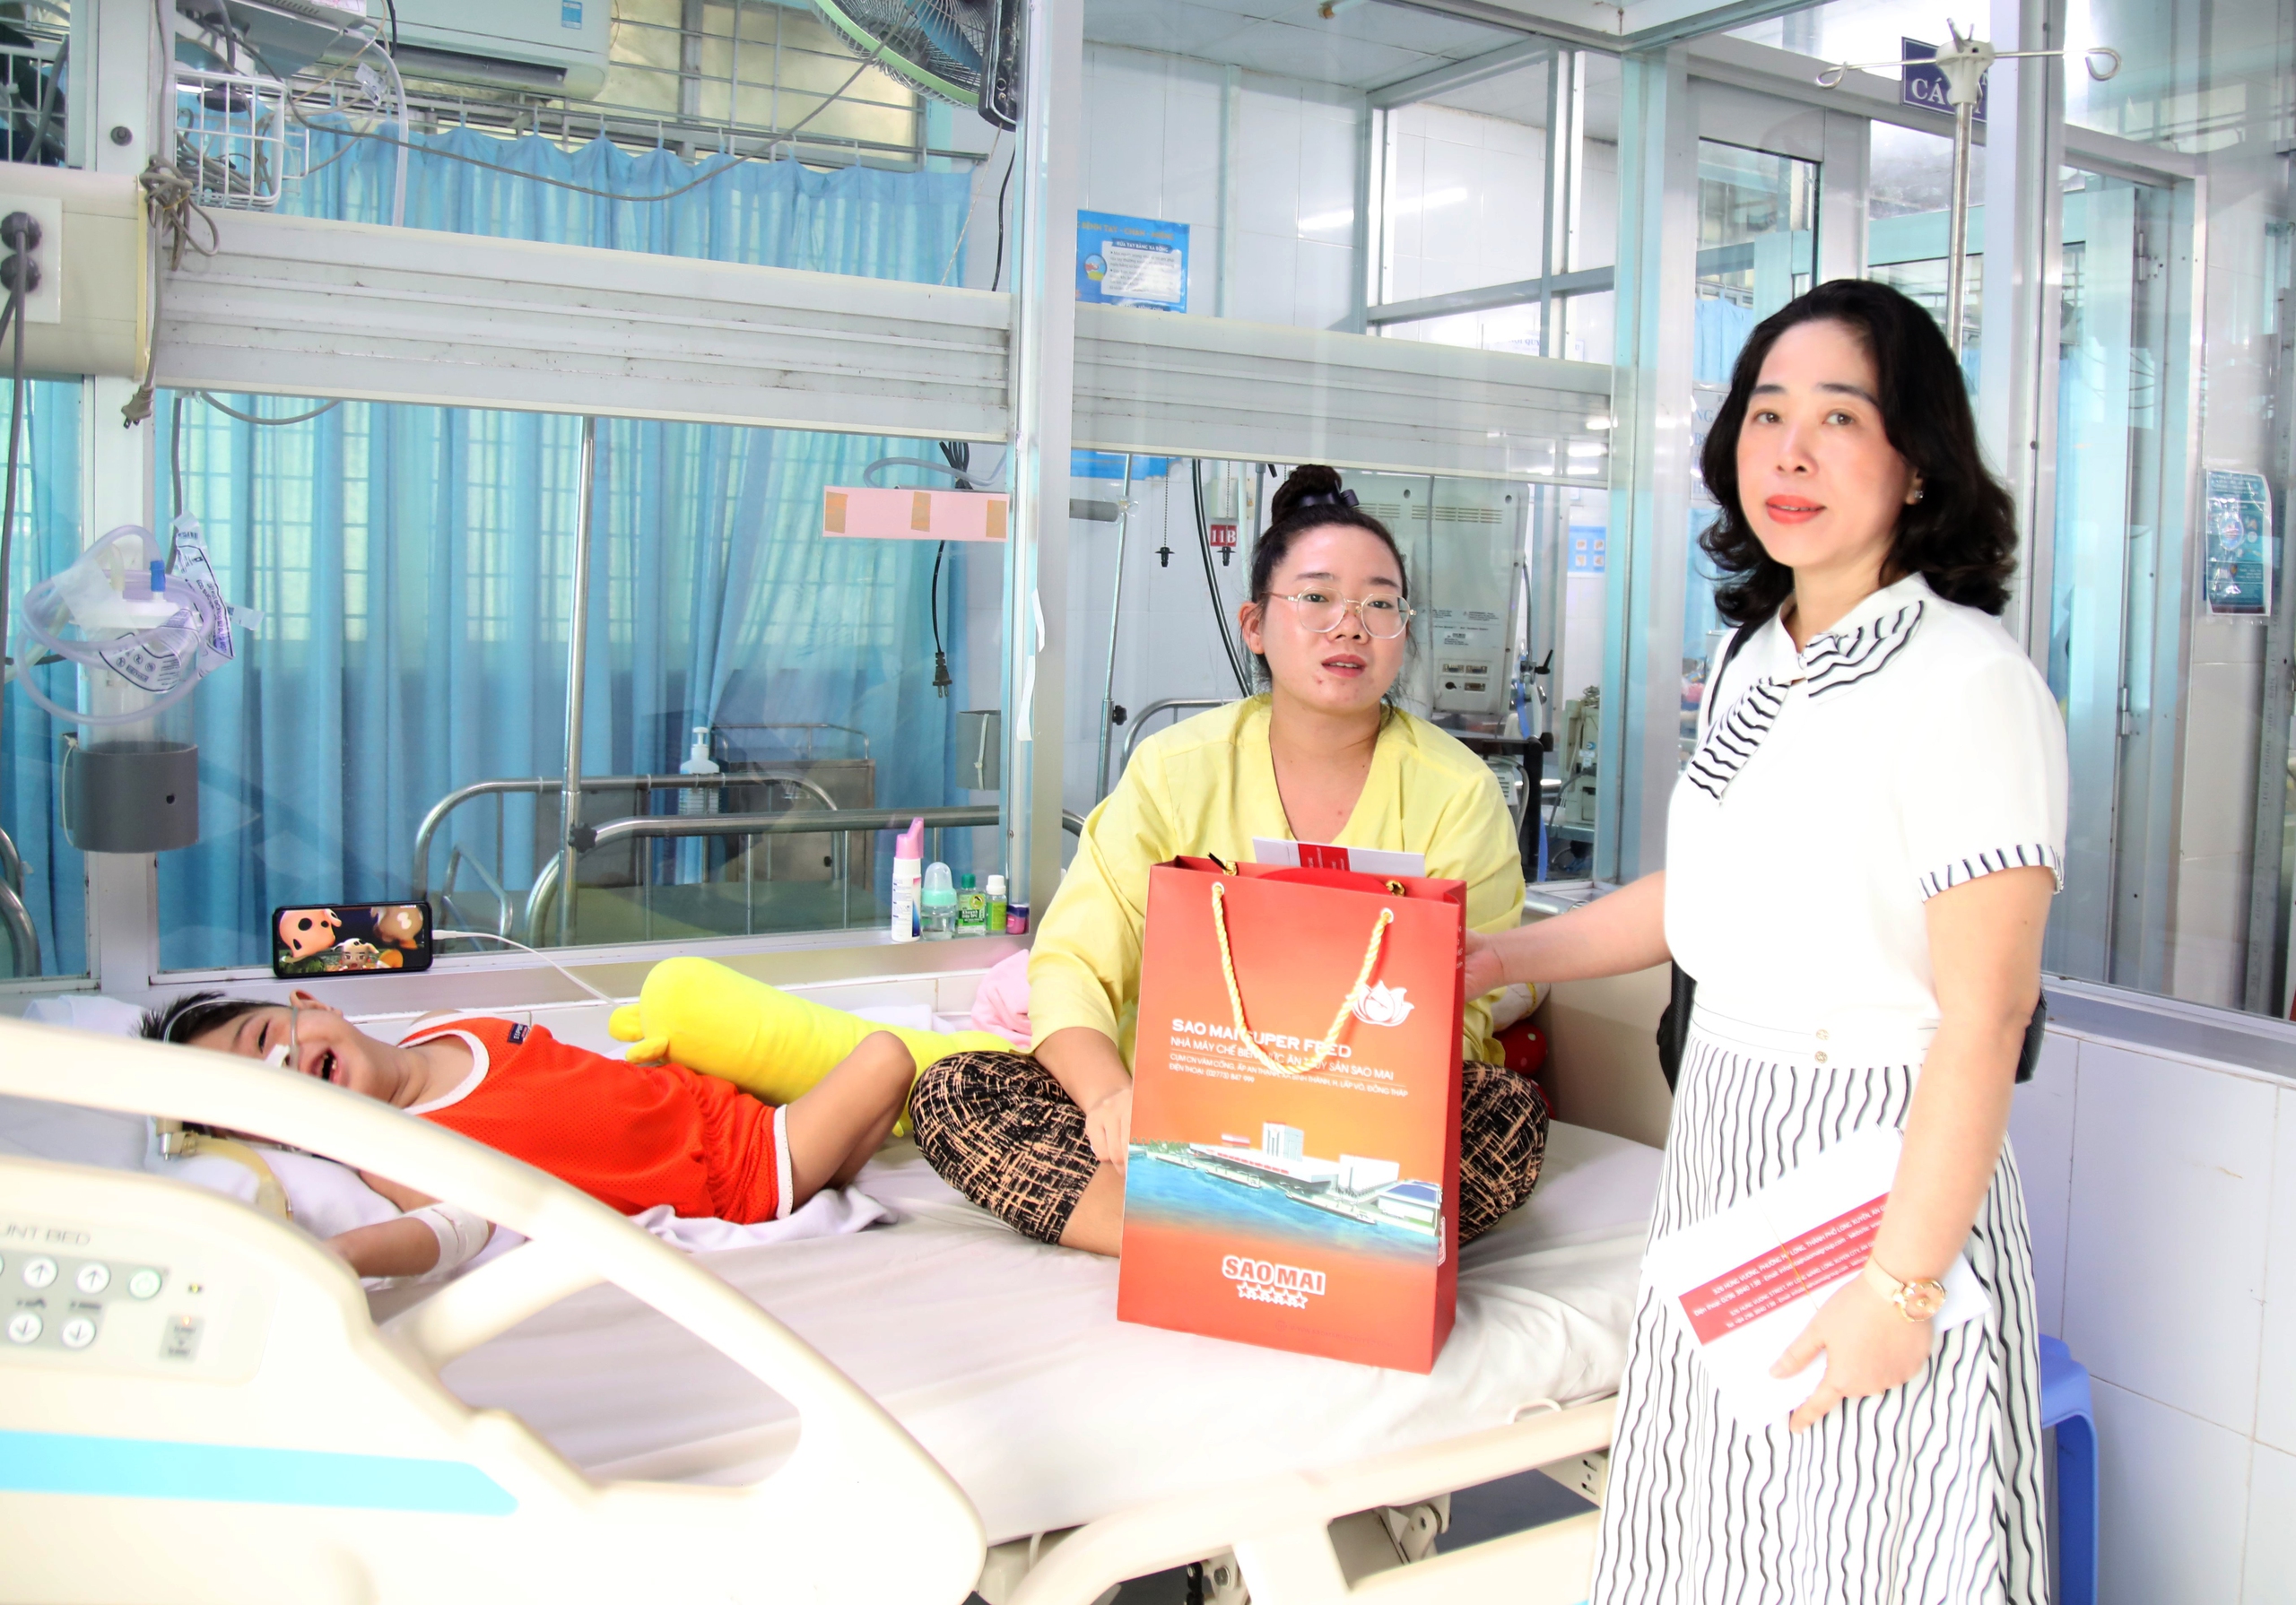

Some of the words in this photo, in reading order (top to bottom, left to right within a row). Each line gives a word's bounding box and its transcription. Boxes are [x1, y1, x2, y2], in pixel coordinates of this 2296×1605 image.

[1212, 529, 1236, 543] 11B
[1172, 1019, 1206, 1036] SAO
[1209, 1024, 1239, 1041] MAI
[1248, 1030, 1300, 1051] UPER
[1303, 1038, 1352, 1058] FEED
[1170, 1036, 1191, 1048] NHÀ
[1193, 1039, 1214, 1052] MÁY
[1216, 1044, 1237, 1056] CHẾ
[1286, 1054, 1302, 1065] ĂN
[1329, 1061, 1349, 1074] SẢN
[1351, 1065, 1372, 1078] SAO
[1374, 1069, 1394, 1080] MAI
[1187, 1056, 1197, 1064] CN
[1837, 1222, 1852, 1233] LONG
[1222, 1254, 1274, 1285] SAO
[1274, 1263, 1326, 1295] MAI
